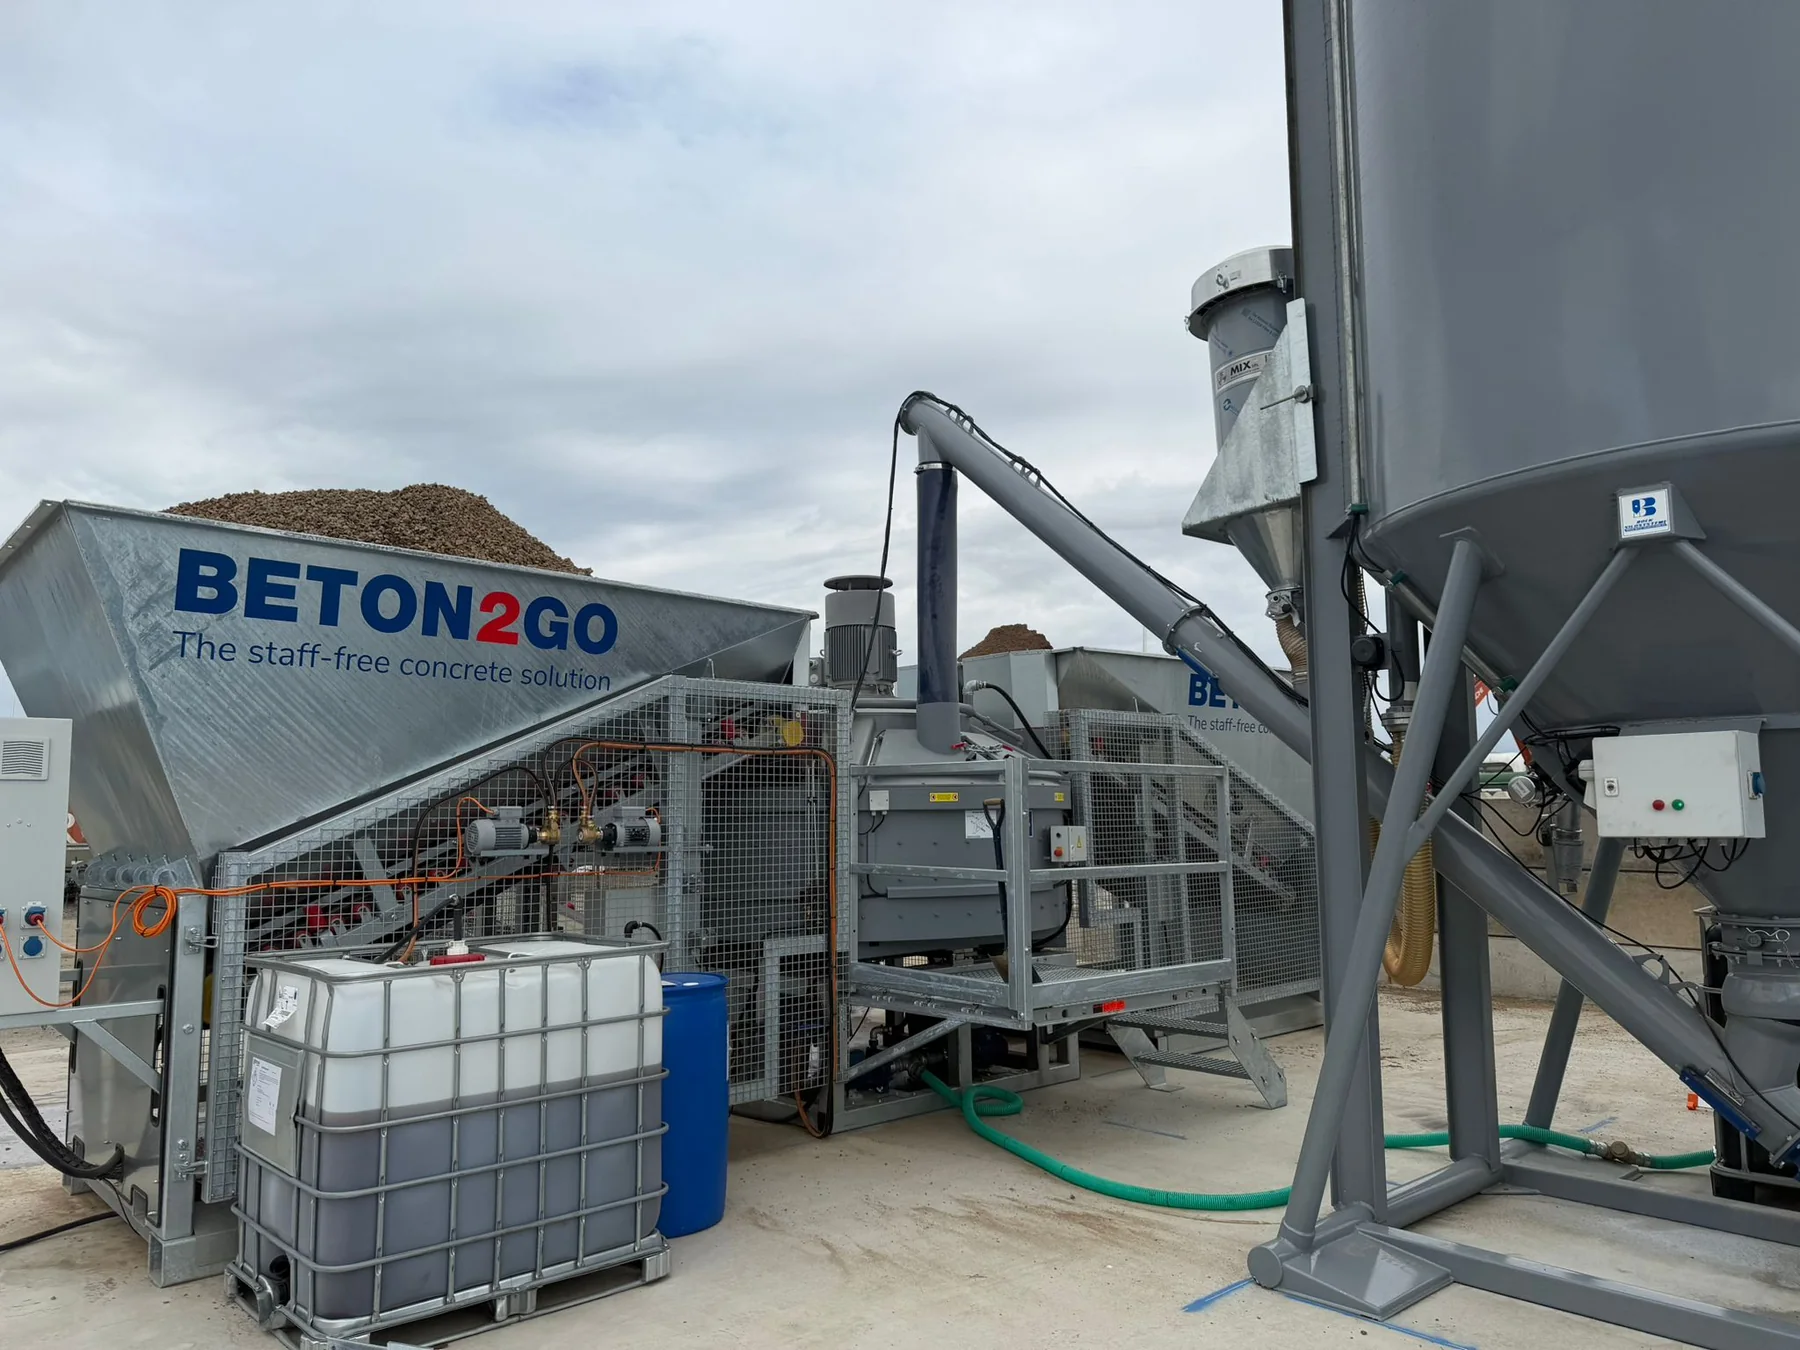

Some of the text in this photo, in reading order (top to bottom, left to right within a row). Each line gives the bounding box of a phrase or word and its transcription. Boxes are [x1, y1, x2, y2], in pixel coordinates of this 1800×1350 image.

[1230, 360, 1251, 376] MIX
[174, 547, 619, 655] BETON2GO
[173, 630, 611, 691] The staff-free concrete solution
[1188, 673, 1239, 709] BE
[1187, 714, 1207, 731] The
[1209, 717, 1256, 733] staff-free
